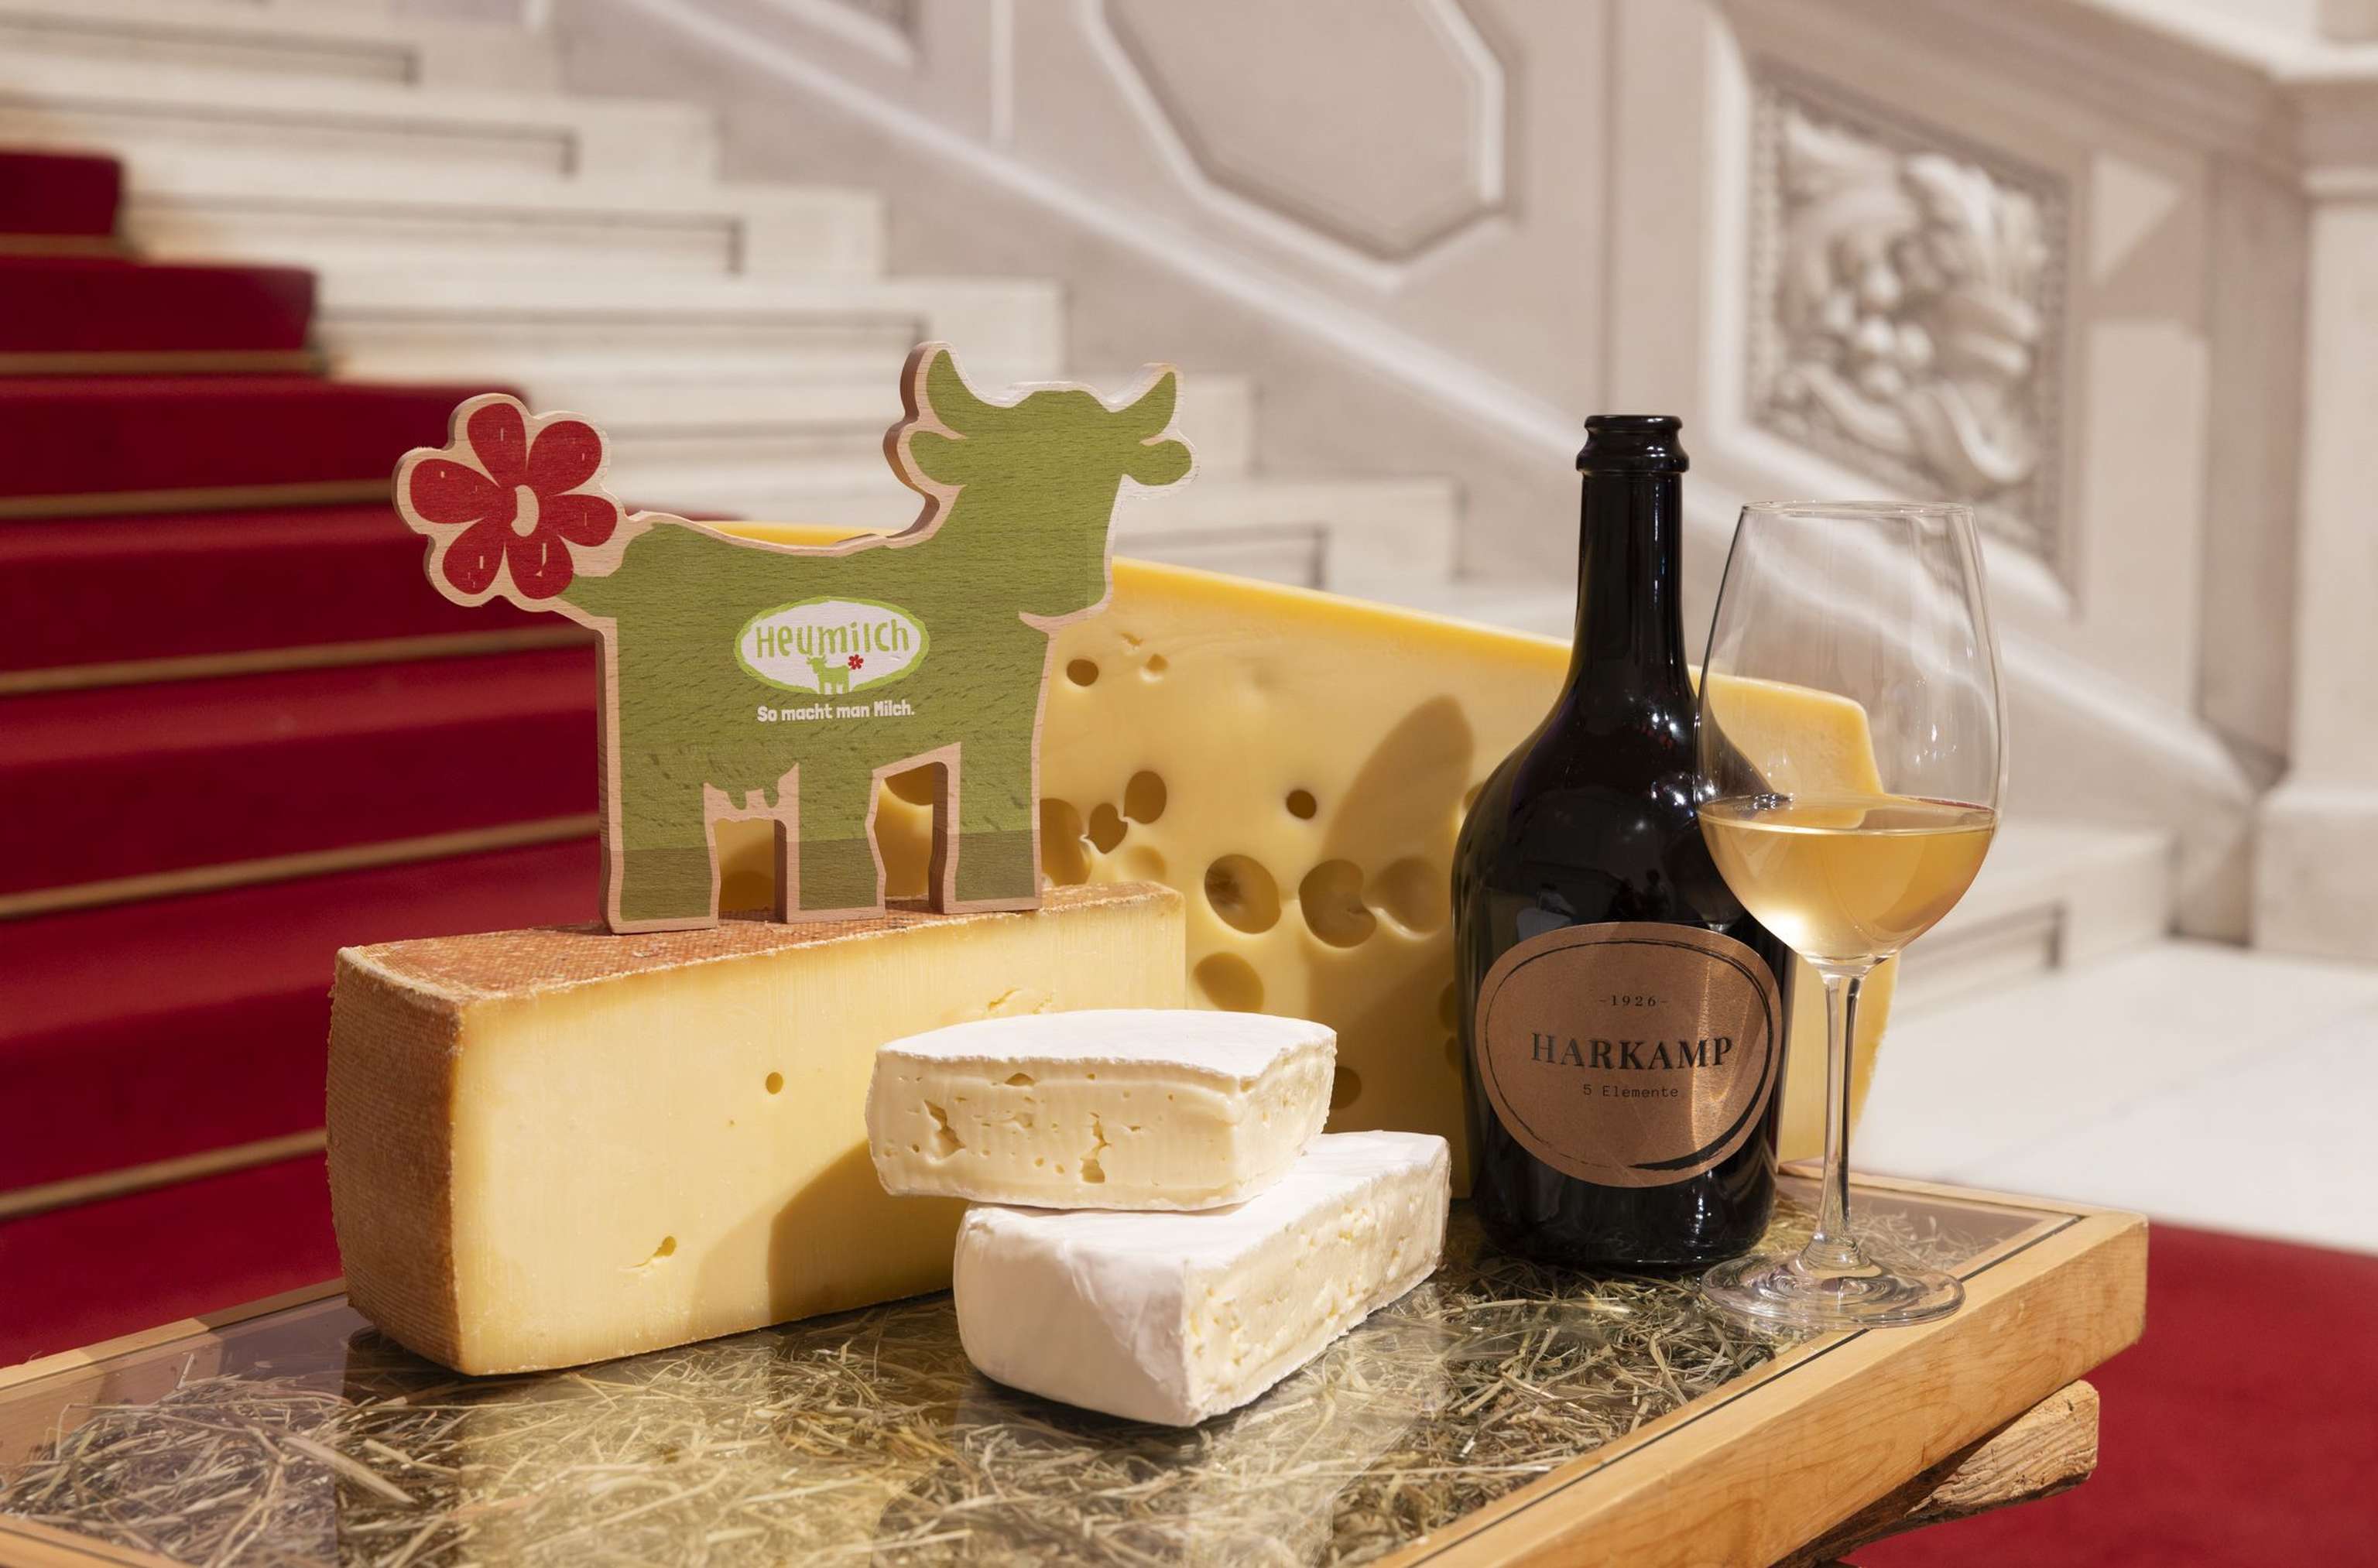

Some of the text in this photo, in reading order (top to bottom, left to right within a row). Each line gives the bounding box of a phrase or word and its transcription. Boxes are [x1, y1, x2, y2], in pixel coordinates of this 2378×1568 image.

[756, 619, 910, 658] Heumilch
[757, 700, 915, 722] So macht man Milch.
[1532, 1032, 1733, 1070] HARKAMP
[1583, 1084, 1592, 1096] 5
